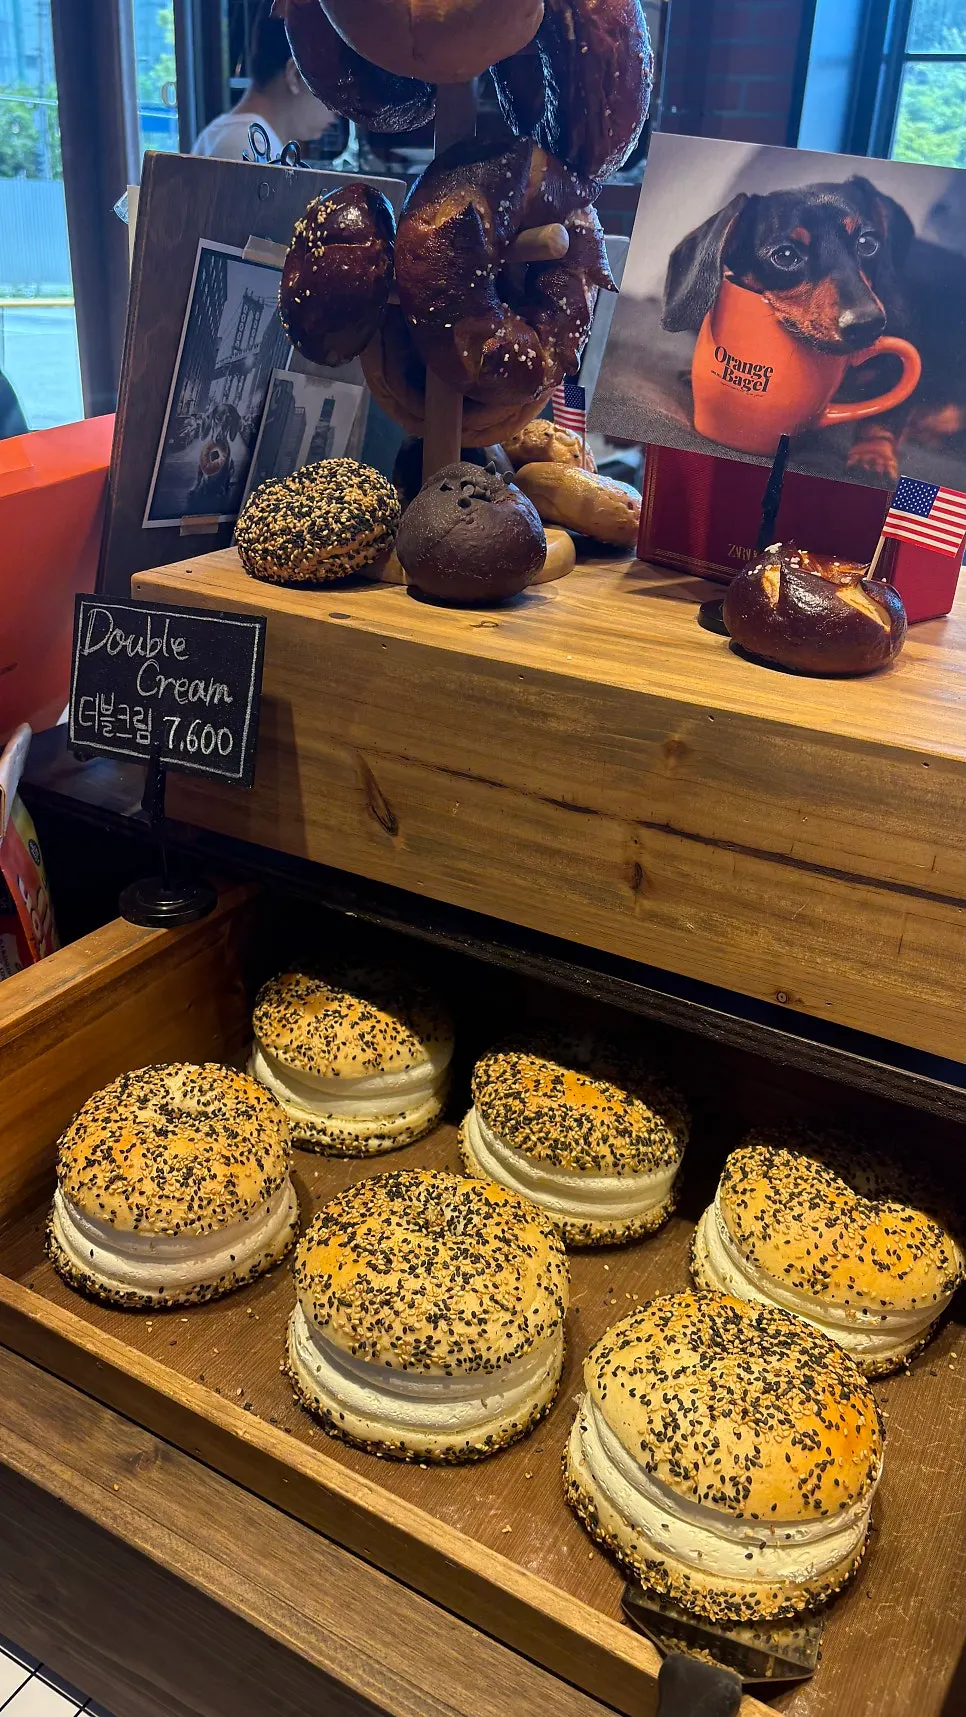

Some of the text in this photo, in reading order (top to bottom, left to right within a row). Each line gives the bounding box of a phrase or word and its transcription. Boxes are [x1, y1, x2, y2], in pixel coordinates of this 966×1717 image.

[714, 346, 774, 379] Orange
[722, 366, 769, 392] Bagel
[80, 609, 189, 660] Double
[136, 659, 233, 706] Cream
[78, 692, 152, 745] 더블크림
